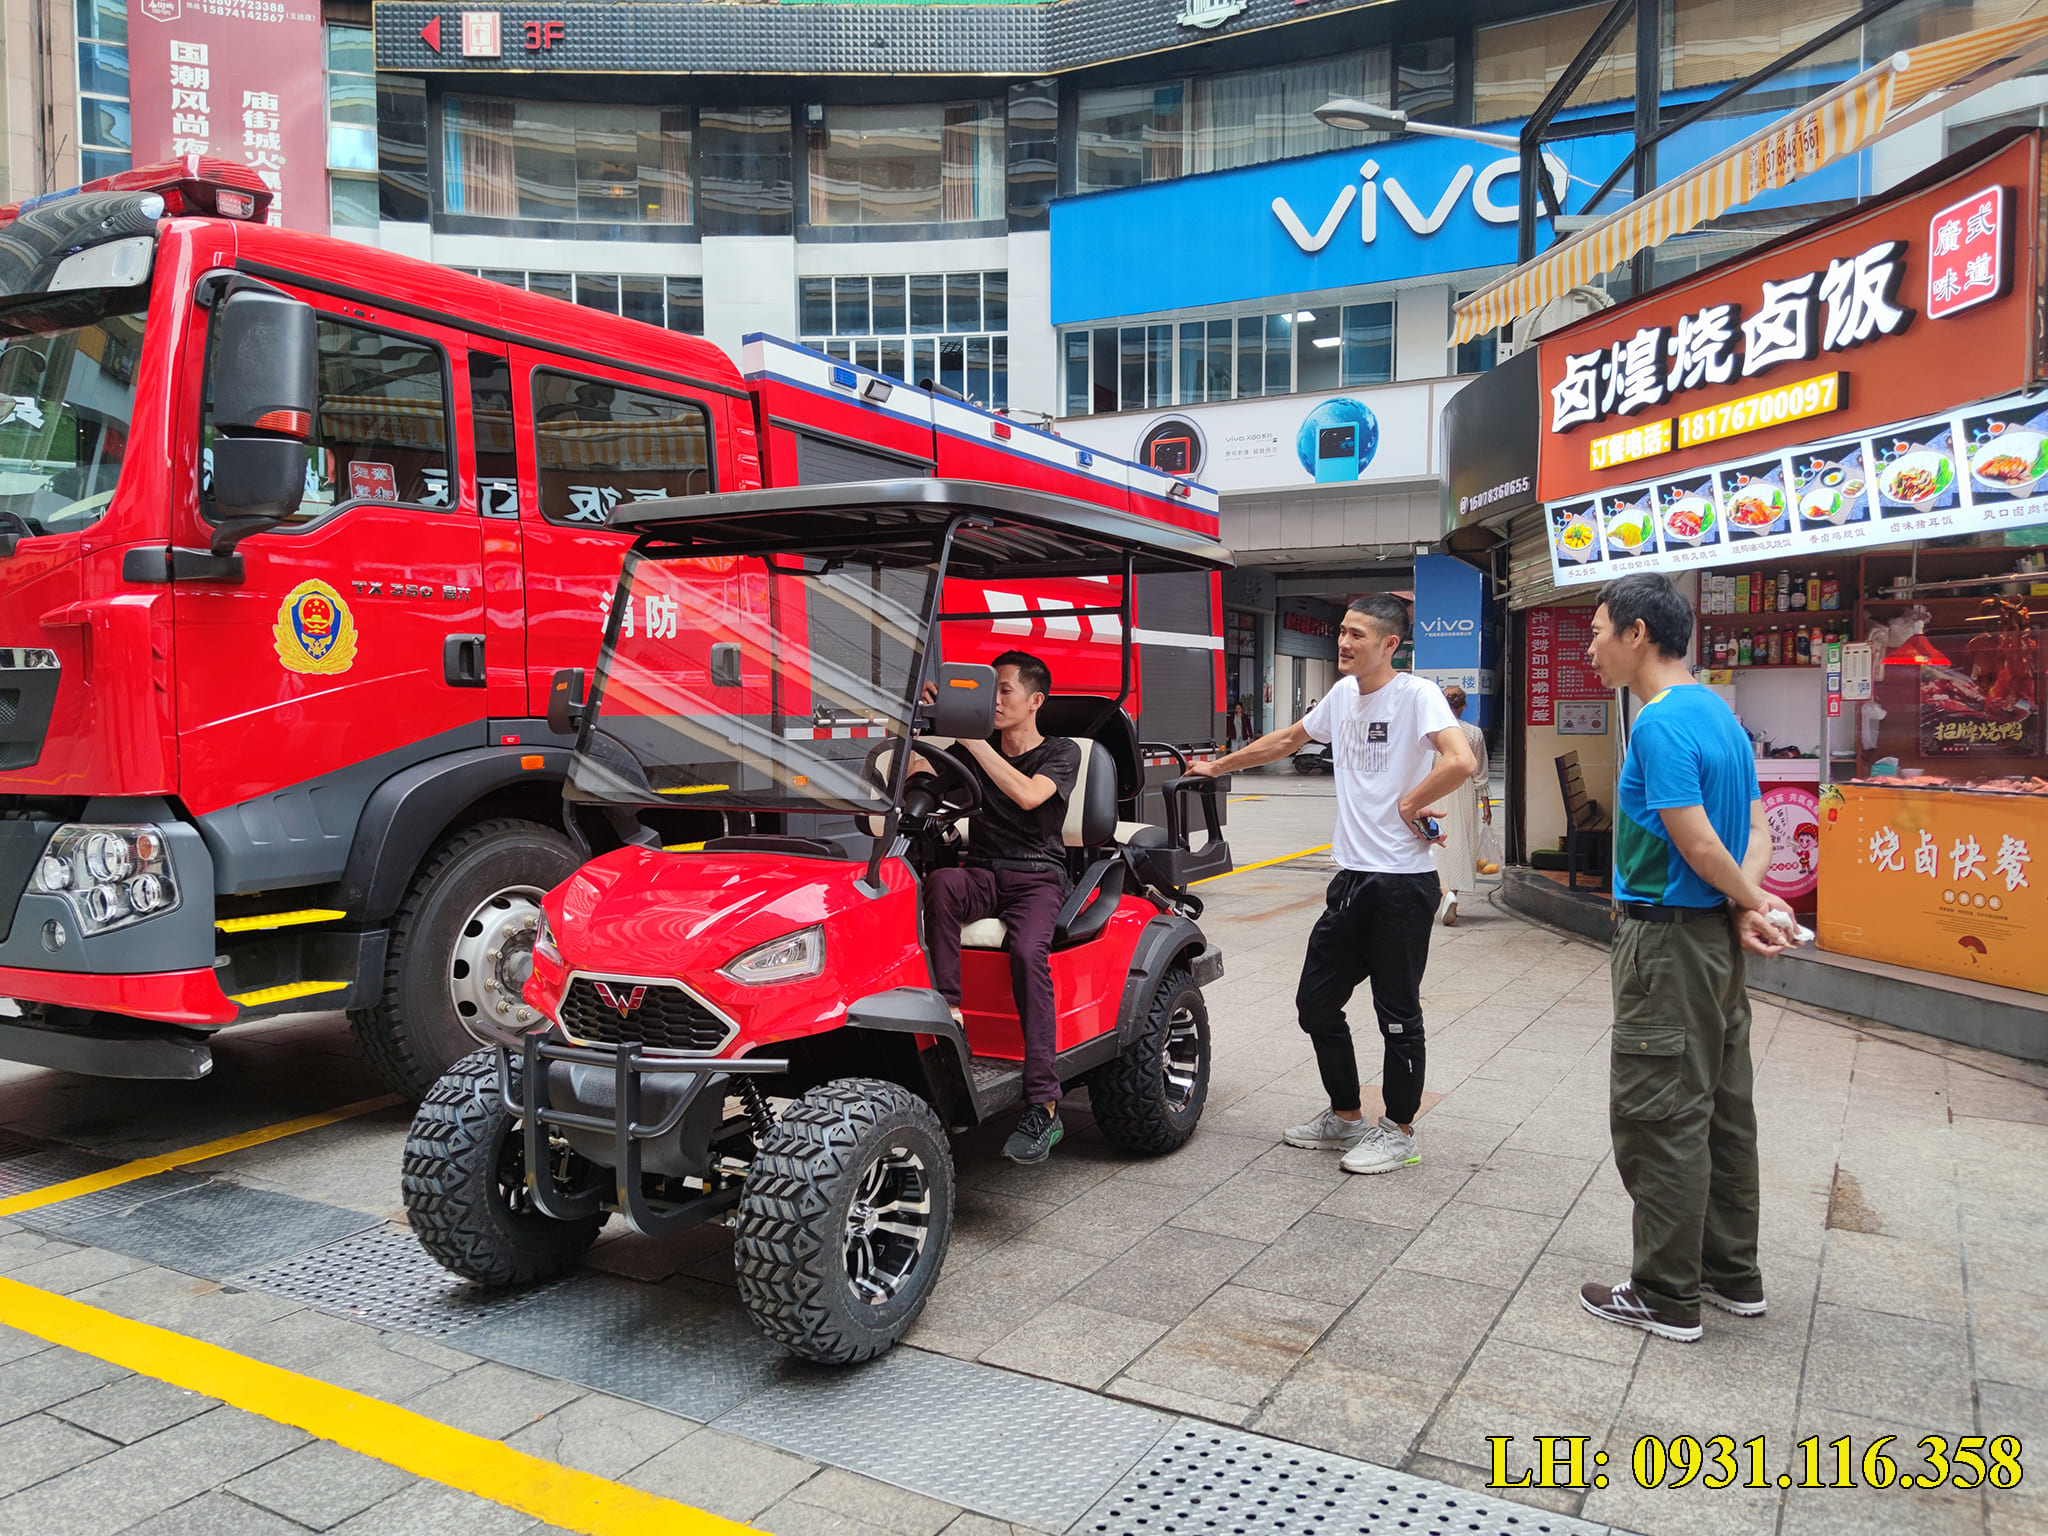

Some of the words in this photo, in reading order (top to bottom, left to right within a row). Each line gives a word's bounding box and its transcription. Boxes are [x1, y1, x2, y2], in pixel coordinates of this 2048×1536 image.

[202, 5, 284, 23] 15874142567
[524, 22, 564, 49] 3F
[1271, 154, 1569, 253] vivo
[1551, 240, 1903, 434] 卤煌烧卤饭
[1680, 376, 1837, 441] 18176700097
[1890, 514, 1954, 533] 卤味猪耳饭
[351, 580, 384, 596] TX
[390, 583, 433, 598] 350
[1420, 617, 1474, 632] vivo
[1532, 611, 1550, 722] 先付款后用餐谢谢
[1934, 721, 2024, 743] 招牌烧鸭
[1869, 826, 2032, 892] 烧卤快餐
